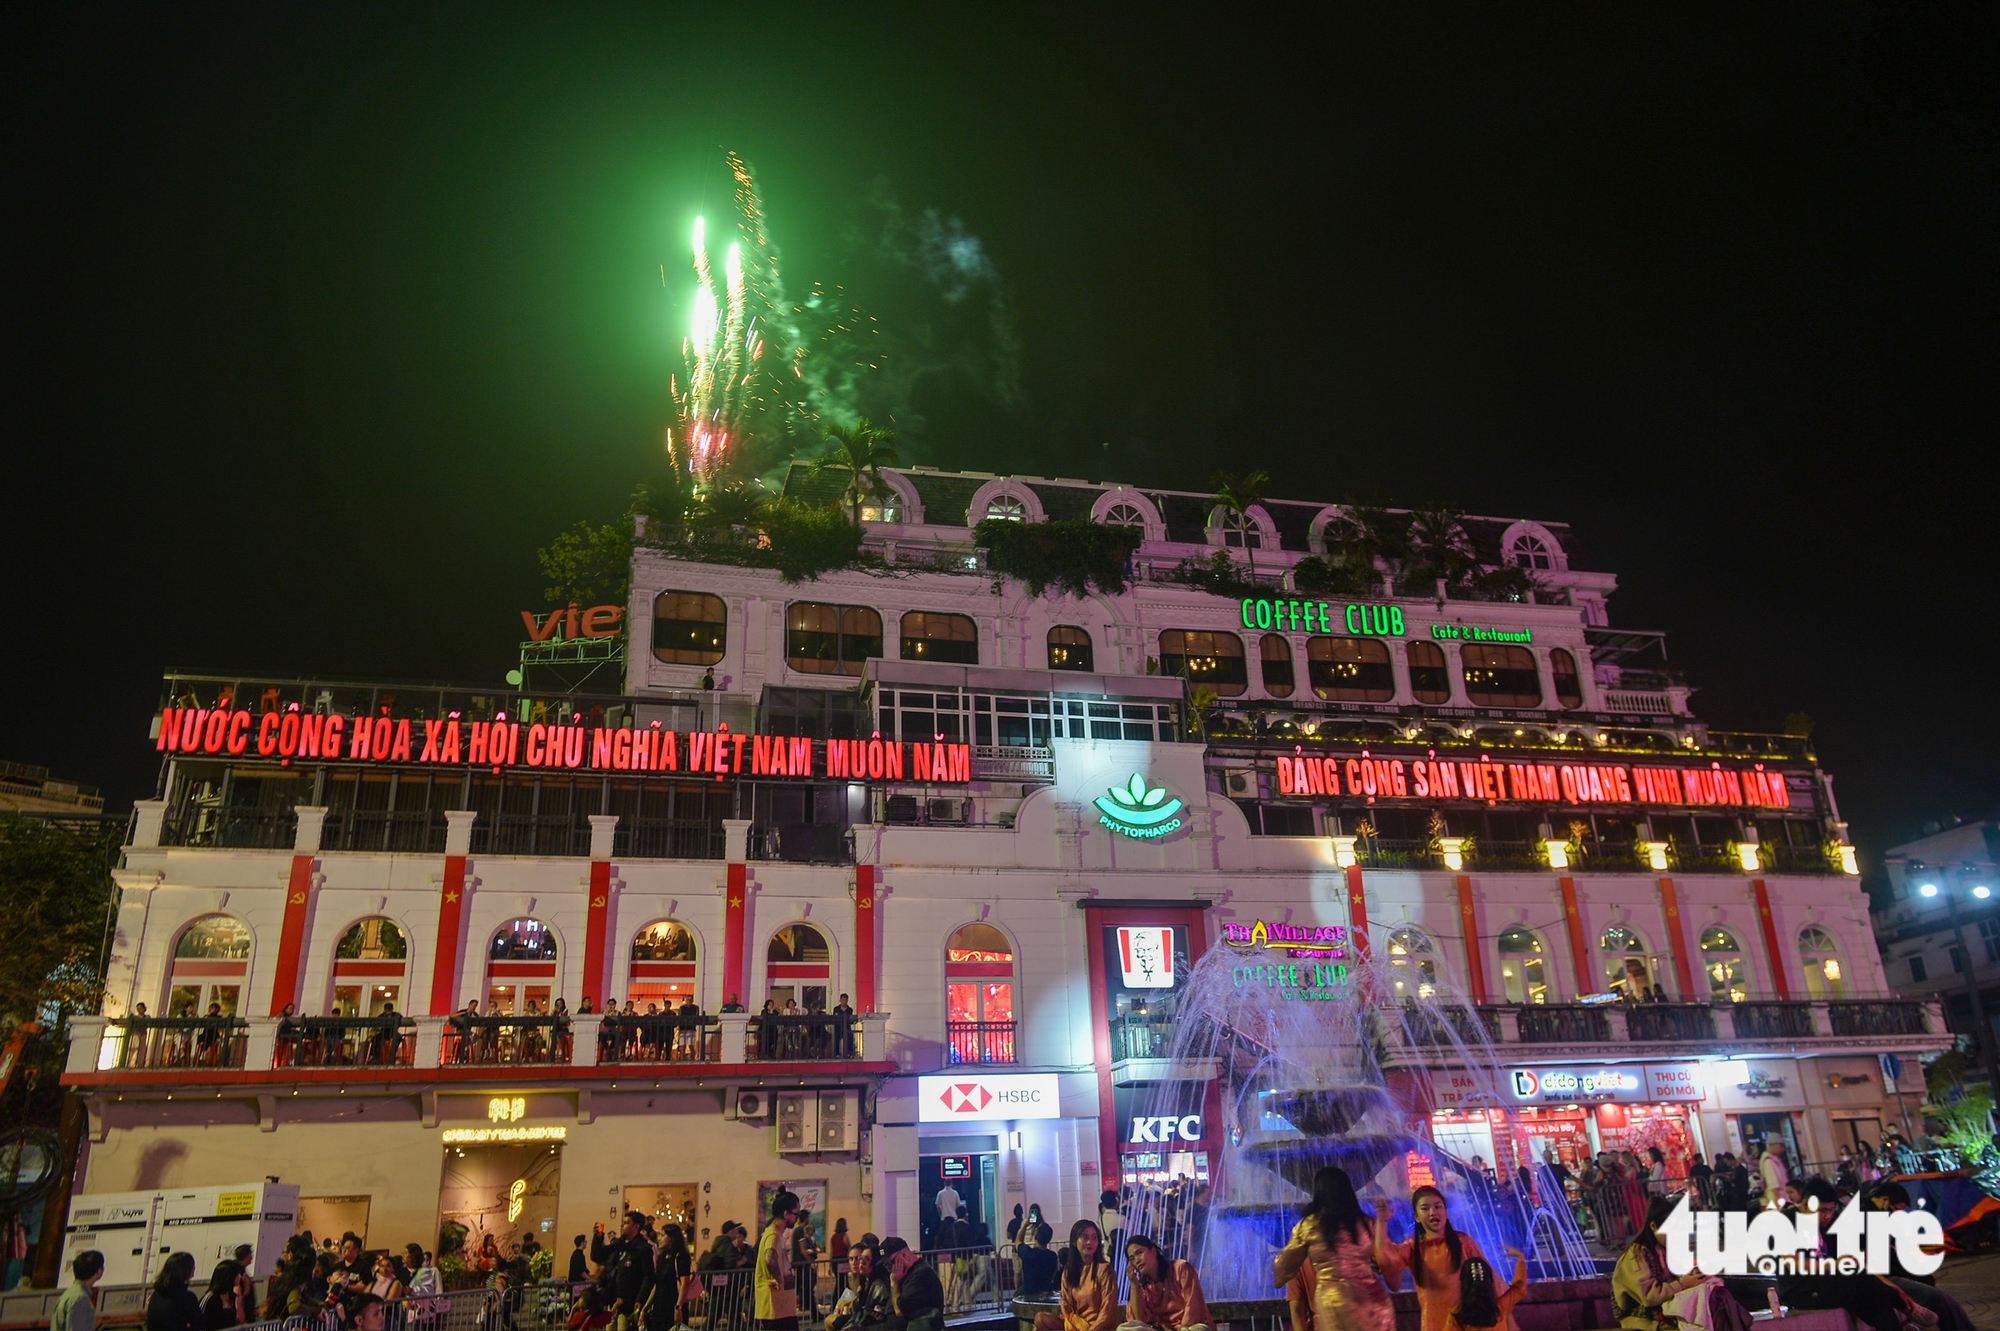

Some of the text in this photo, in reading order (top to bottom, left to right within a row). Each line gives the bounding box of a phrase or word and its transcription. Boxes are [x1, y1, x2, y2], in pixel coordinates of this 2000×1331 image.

[1240, 598, 1405, 636] COFFEE CLUB
[1462, 625, 1471, 640] &
[1473, 626, 1532, 642] Restaurant
[156, 698, 971, 782] NƯỚC CỘNG HÒA XÃ HỘI CHỦ NGHĨA VIỆT NAM MUÔN NĂM
[1276, 745, 1791, 807] ĐẢNG CỘNG SẢN VIỆT NAM QUANG VINH MUÔN NĂM
[1098, 815, 1181, 838] PHYTOPHARCO
[1233, 964, 1298, 988] COFFEE
[1451, 1075, 1475, 1088] BÁN
[1655, 1069, 1692, 1082] THU CŨ
[998, 1089, 1041, 1103] HSBC
[1129, 1114, 1201, 1143] KFC
[180, 1217, 203, 1225] POWER
